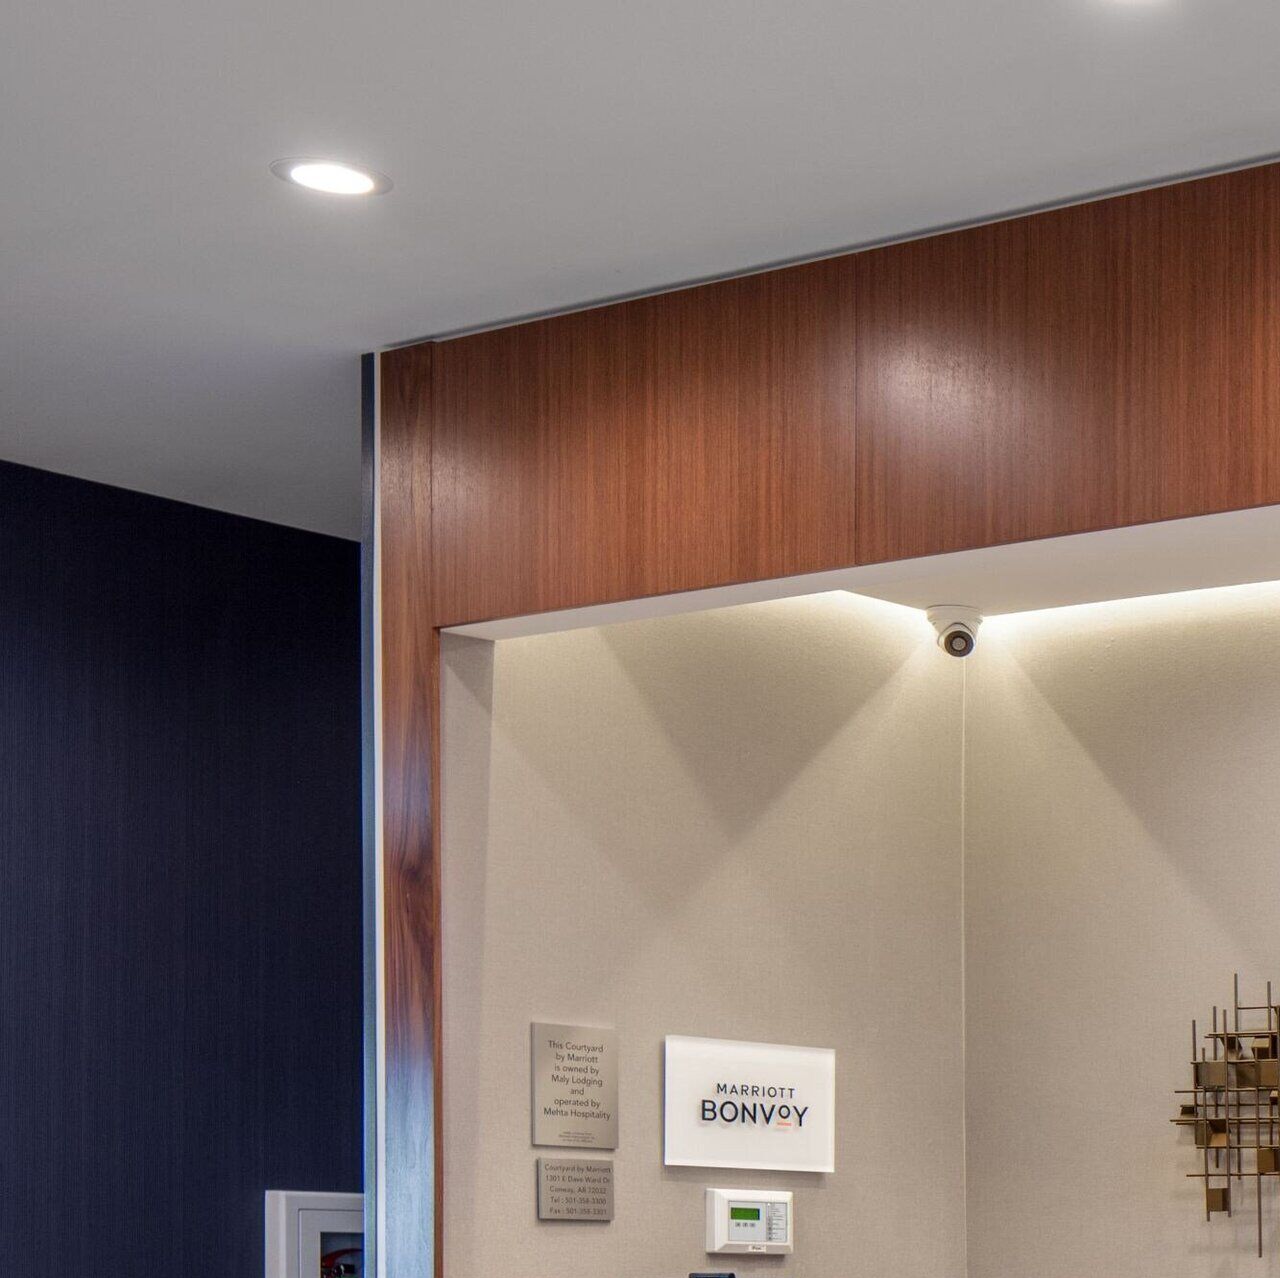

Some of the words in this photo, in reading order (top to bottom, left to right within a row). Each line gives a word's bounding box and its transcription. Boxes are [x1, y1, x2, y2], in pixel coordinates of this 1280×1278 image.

[548, 1040, 563, 1050] This
[565, 1042, 604, 1053] Courtyard
[556, 1053, 565, 1062] by
[567, 1054, 598, 1063] Marriott
[555, 1064, 560, 1072] is
[562, 1065, 588, 1074] owned
[590, 1066, 599, 1075] by
[552, 1075, 569, 1085] Maly
[572, 1077, 603, 1088] Lodging
[570, 1088, 584, 1096] and
[716, 1083, 795, 1099] MARRIOTT
[554, 1099, 589, 1108] operated
[591, 1100, 600, 1109] by
[543, 1108, 569, 1117] Mehta
[570, 1109, 611, 1121] Hospitality
[545, 1163, 575, 1173] Courtyard
